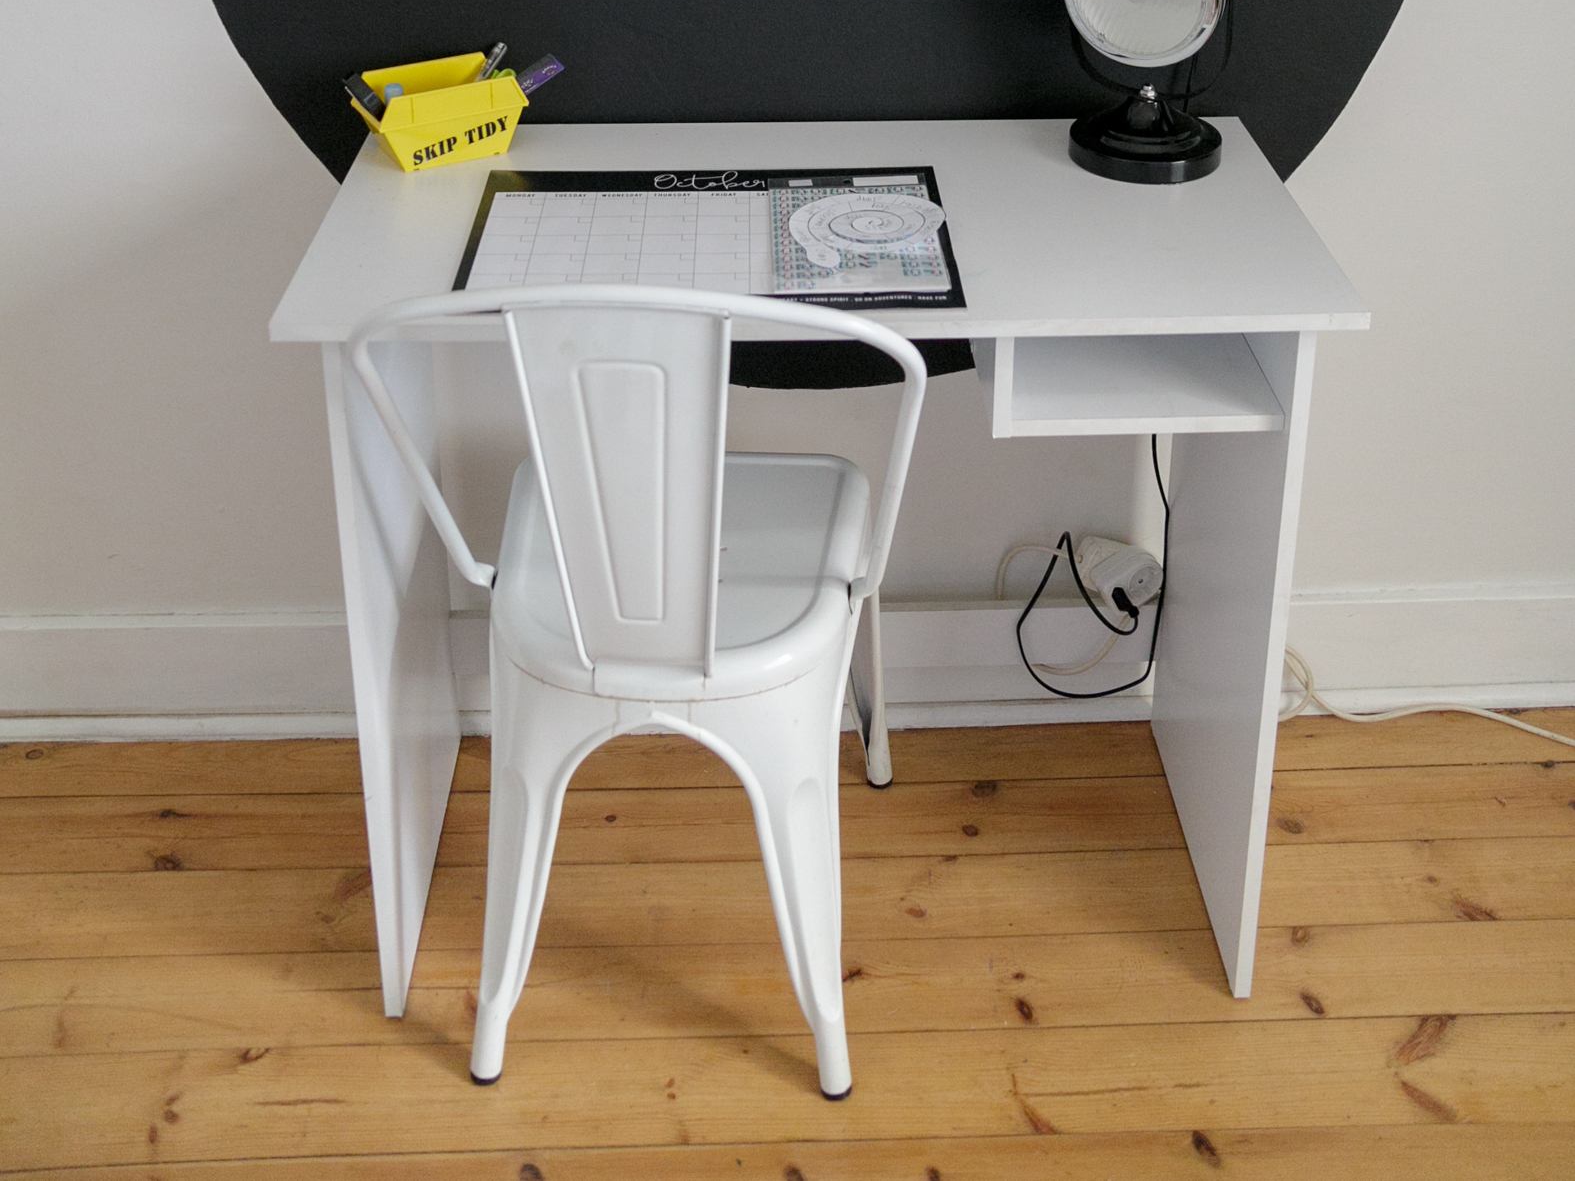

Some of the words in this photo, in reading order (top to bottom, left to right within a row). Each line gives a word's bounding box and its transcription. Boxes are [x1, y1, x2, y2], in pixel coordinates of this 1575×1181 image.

[413, 136, 458, 166] SKIP
[464, 116, 508, 145] TIDY
[654, 171, 765, 189] October
